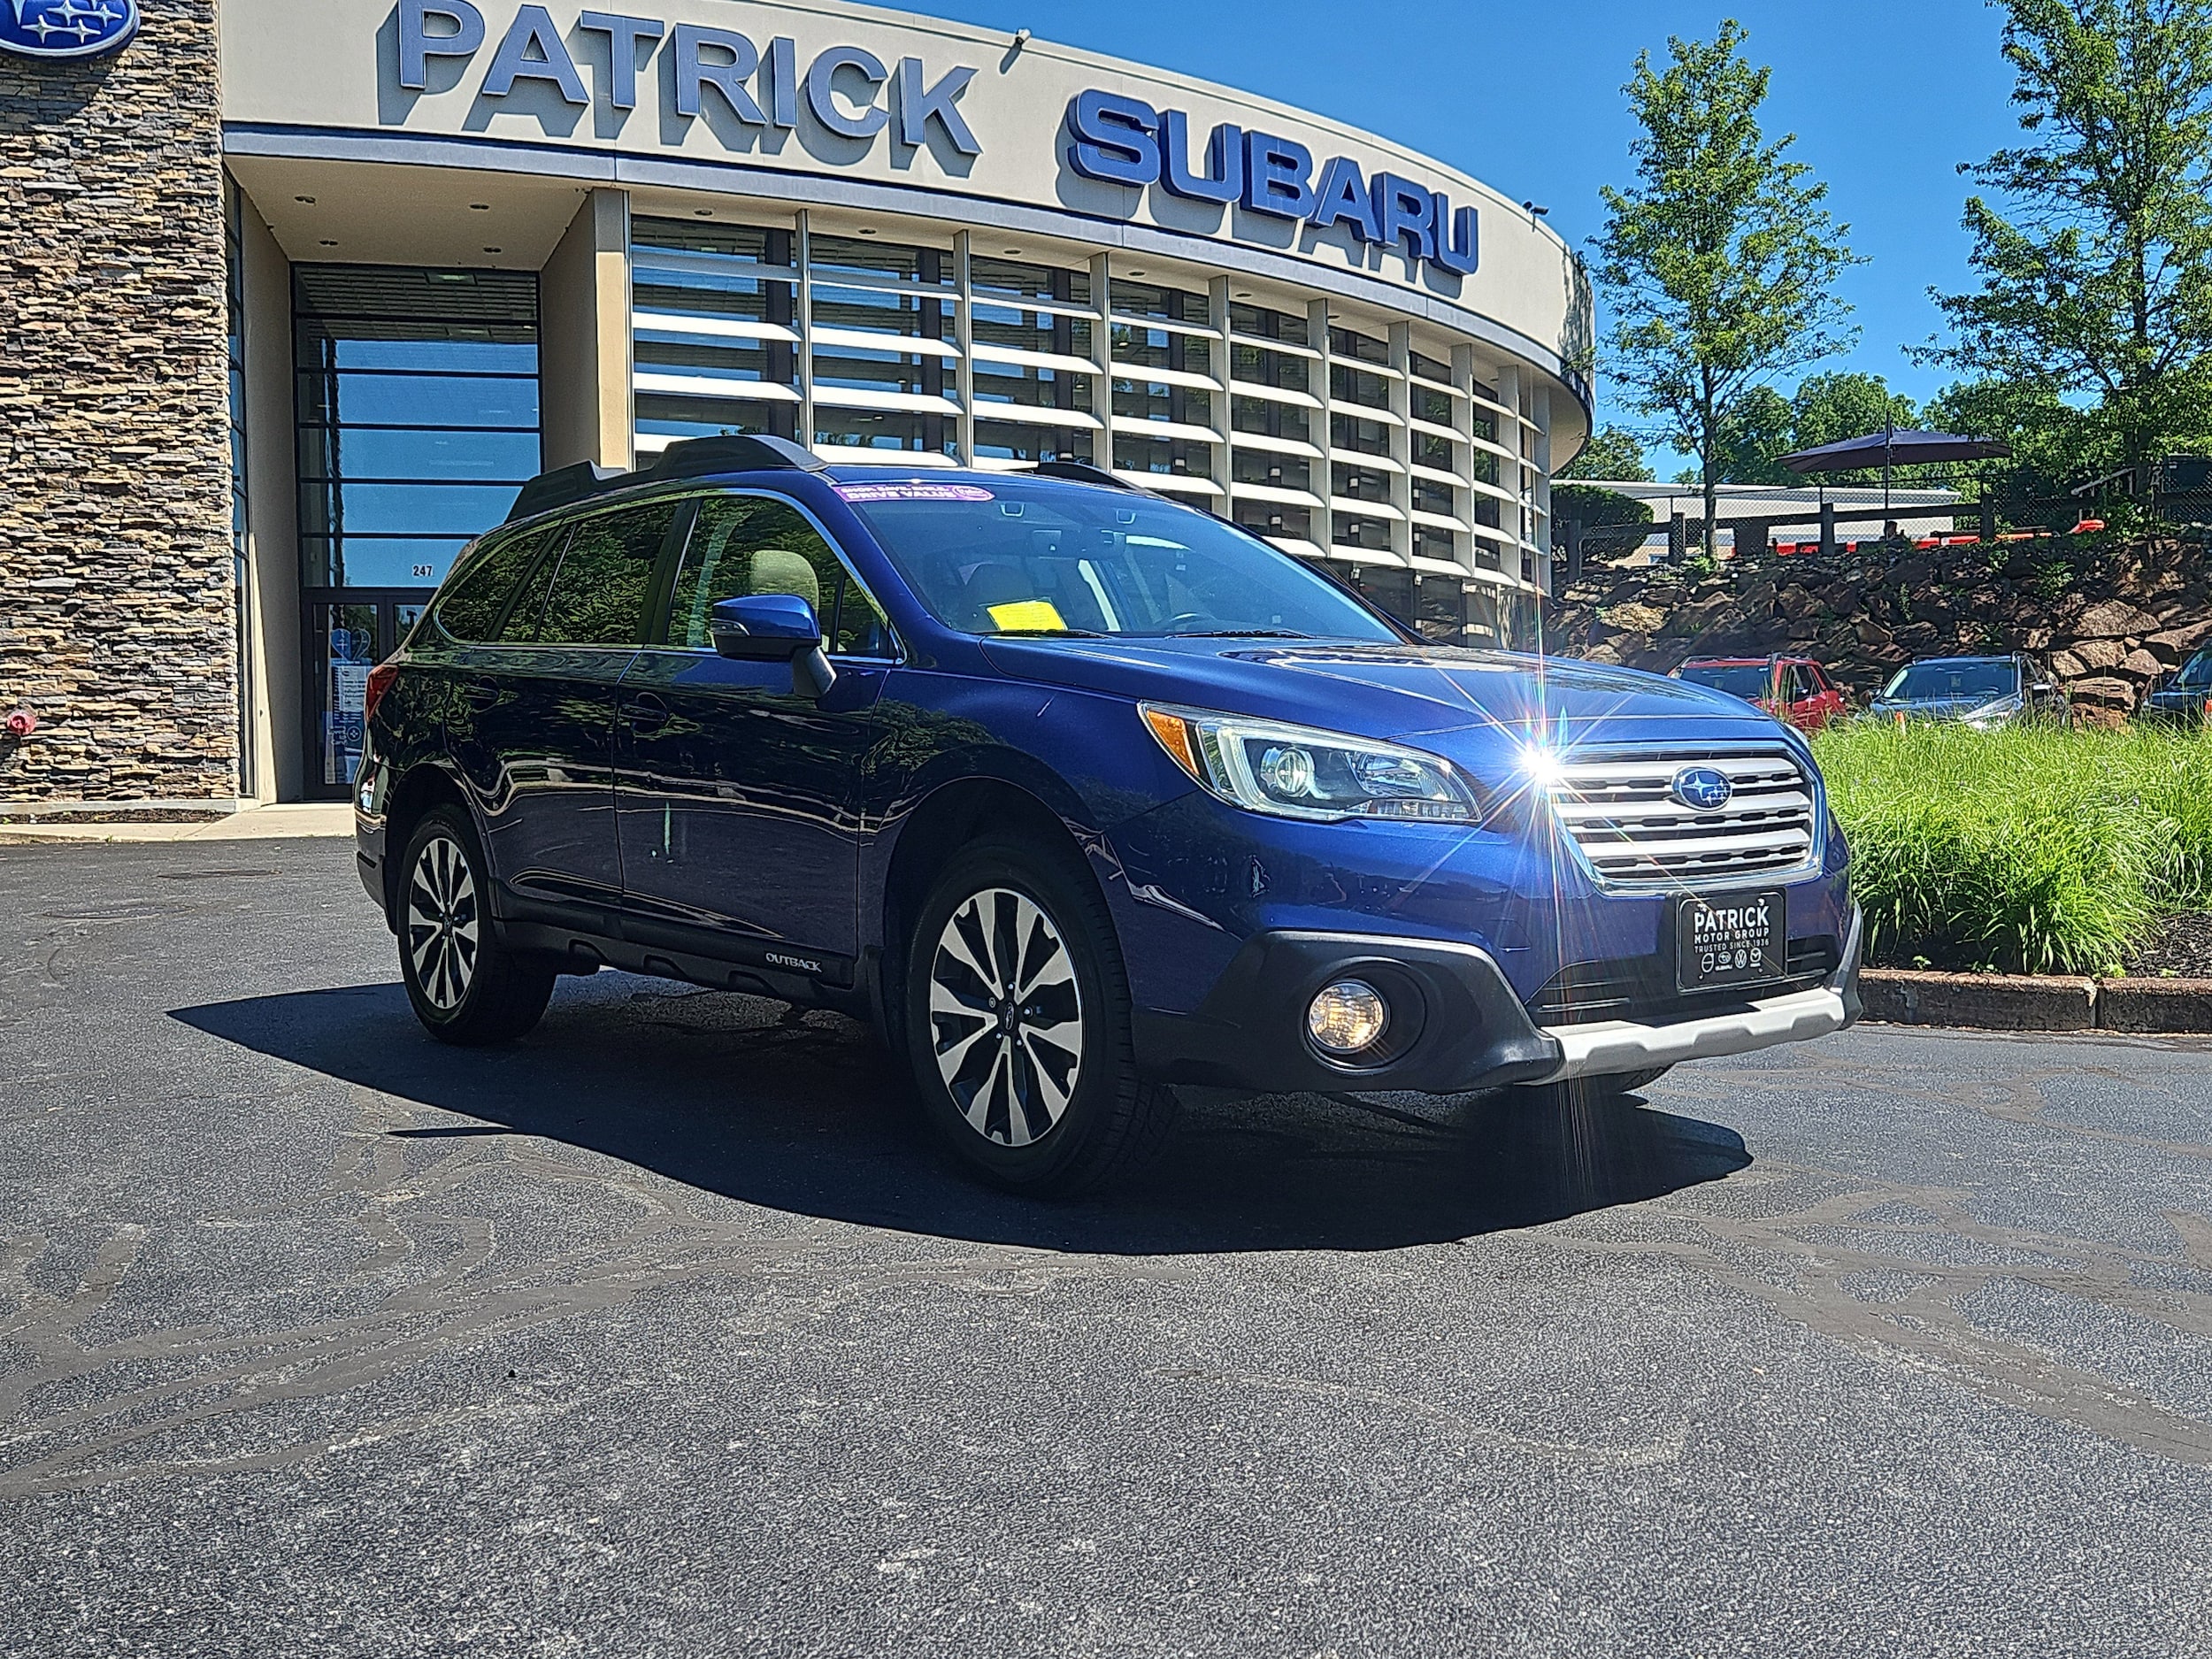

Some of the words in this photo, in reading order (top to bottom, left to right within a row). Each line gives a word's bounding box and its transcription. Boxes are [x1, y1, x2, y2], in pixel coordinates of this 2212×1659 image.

[399, 0, 982, 155] PATRICK
[1067, 88, 1479, 277] SUBARU
[413, 565, 433, 576] 247
[1694, 906, 1770, 933] PATRICK
[1694, 932, 1730, 944] MOTOR
[1735, 927, 1770, 940] GROUP
[1694, 944, 1727, 954] TRUSTED
[1730, 940, 1750, 949] SINCE
[766, 953, 822, 972] OUTBACK
